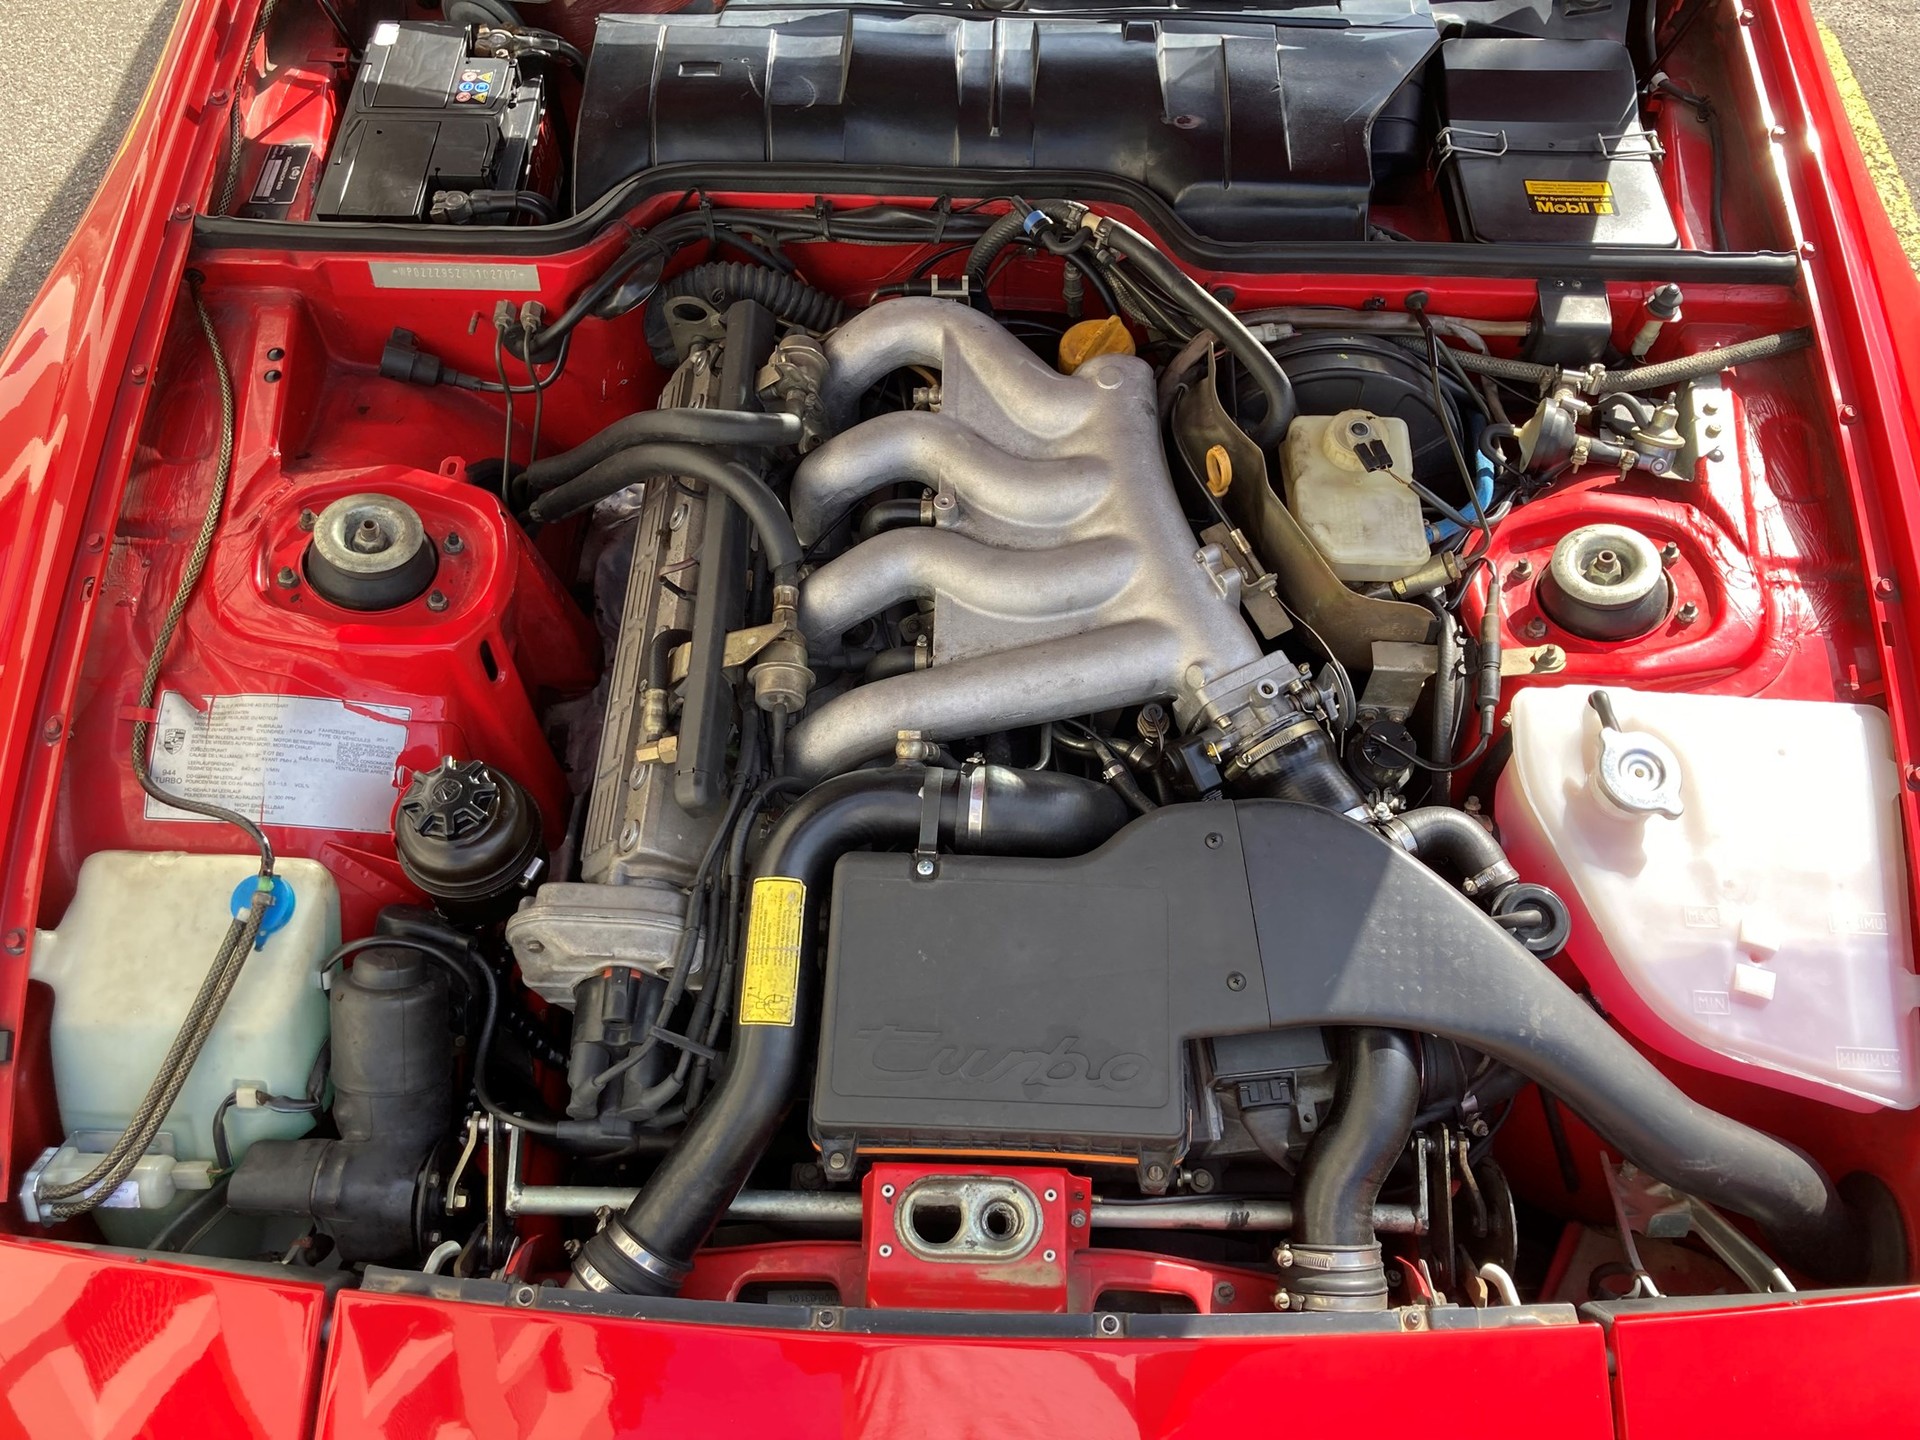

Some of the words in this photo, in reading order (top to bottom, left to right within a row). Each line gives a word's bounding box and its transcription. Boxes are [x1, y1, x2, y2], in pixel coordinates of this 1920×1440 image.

[1536, 201, 1590, 214] Mobil
[155, 776, 183, 785] TURBO
[1697, 996, 1726, 1010] MIN
